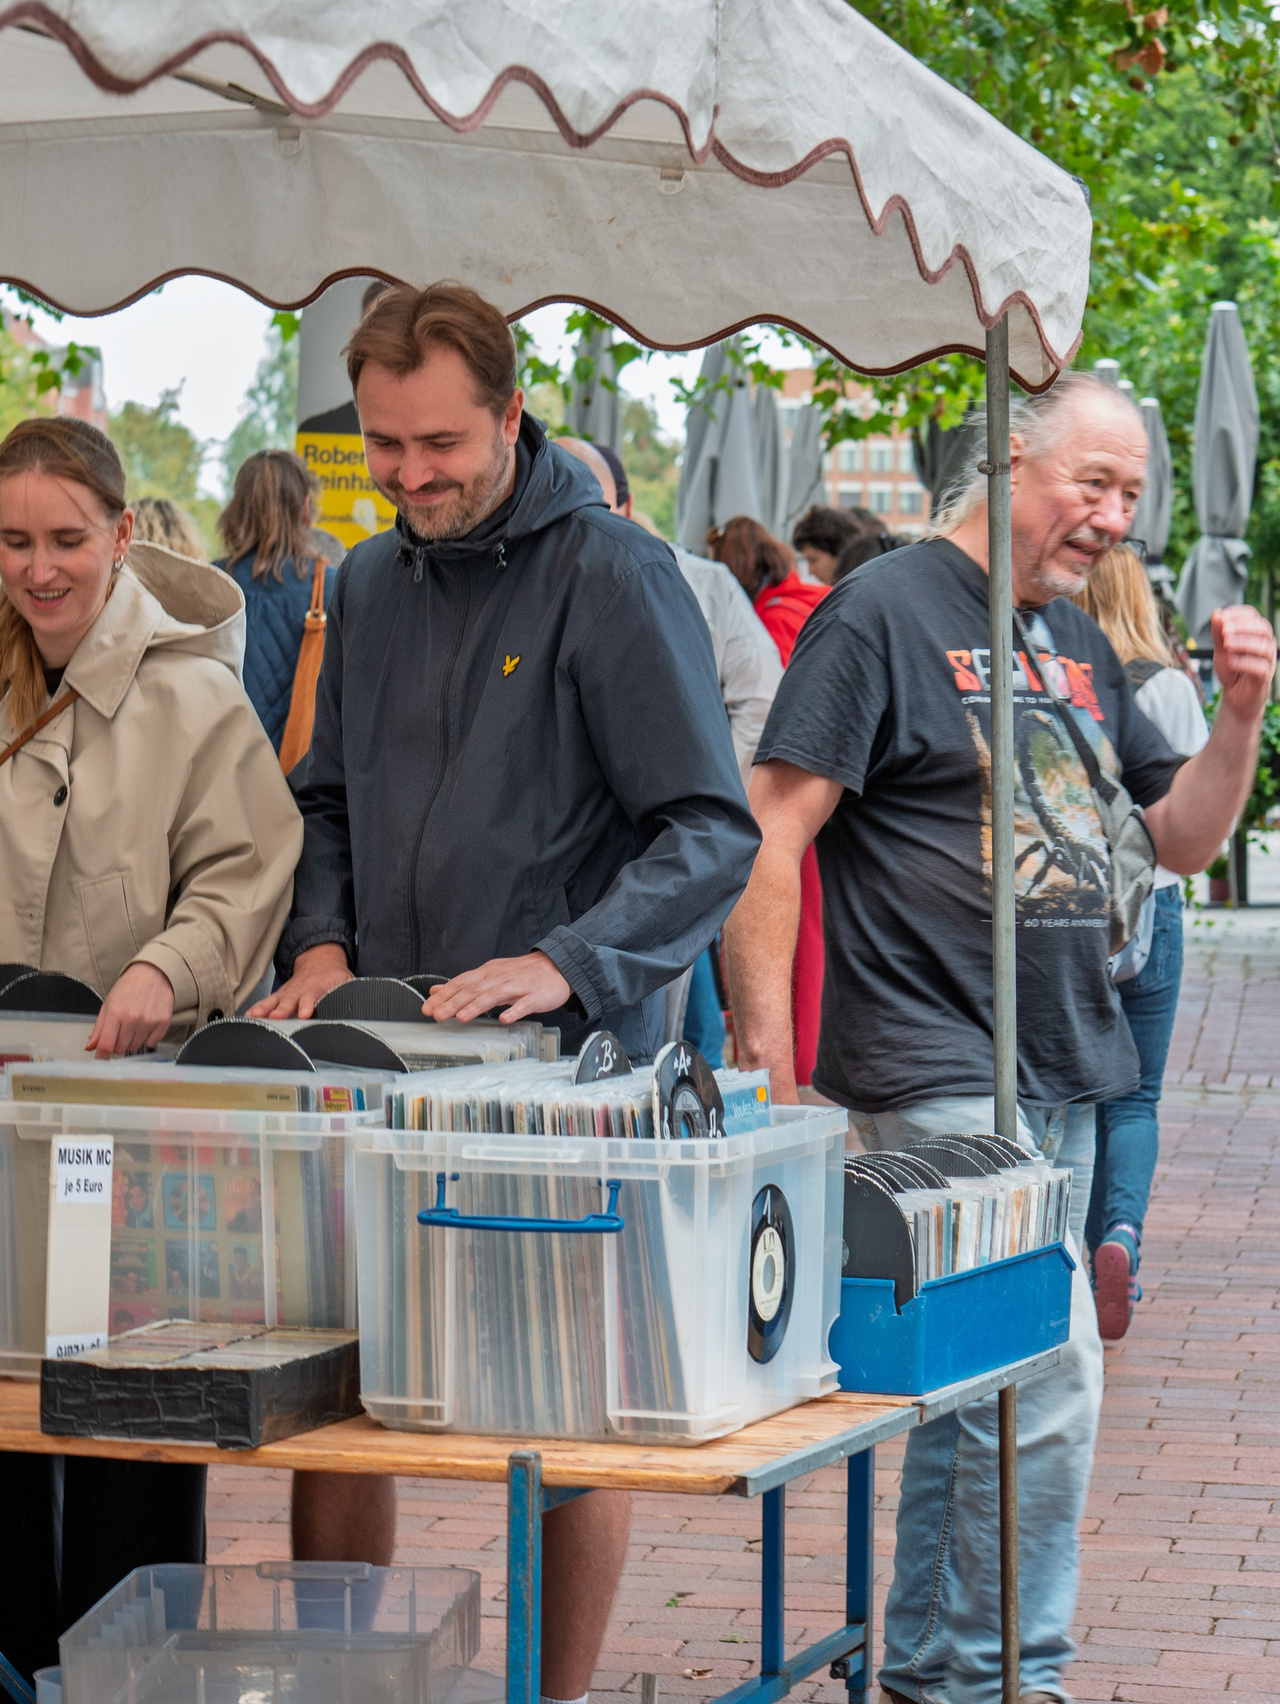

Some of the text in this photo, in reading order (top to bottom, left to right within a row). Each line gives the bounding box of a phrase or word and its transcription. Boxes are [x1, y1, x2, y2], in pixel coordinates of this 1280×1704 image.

[304, 444, 365, 465] Rober
[320, 470, 377, 491] einha
[1023, 918, 1040, 928] 60
[1040, 918, 1070, 928] YEARS
[596, 1039, 614, 1078] B
[677, 1045, 689, 1077] A
[22, 1085, 46, 1093] STEREO
[58, 1148, 112, 1166] MUSIK MC
[64, 1177, 103, 1195] je 5 Euro
